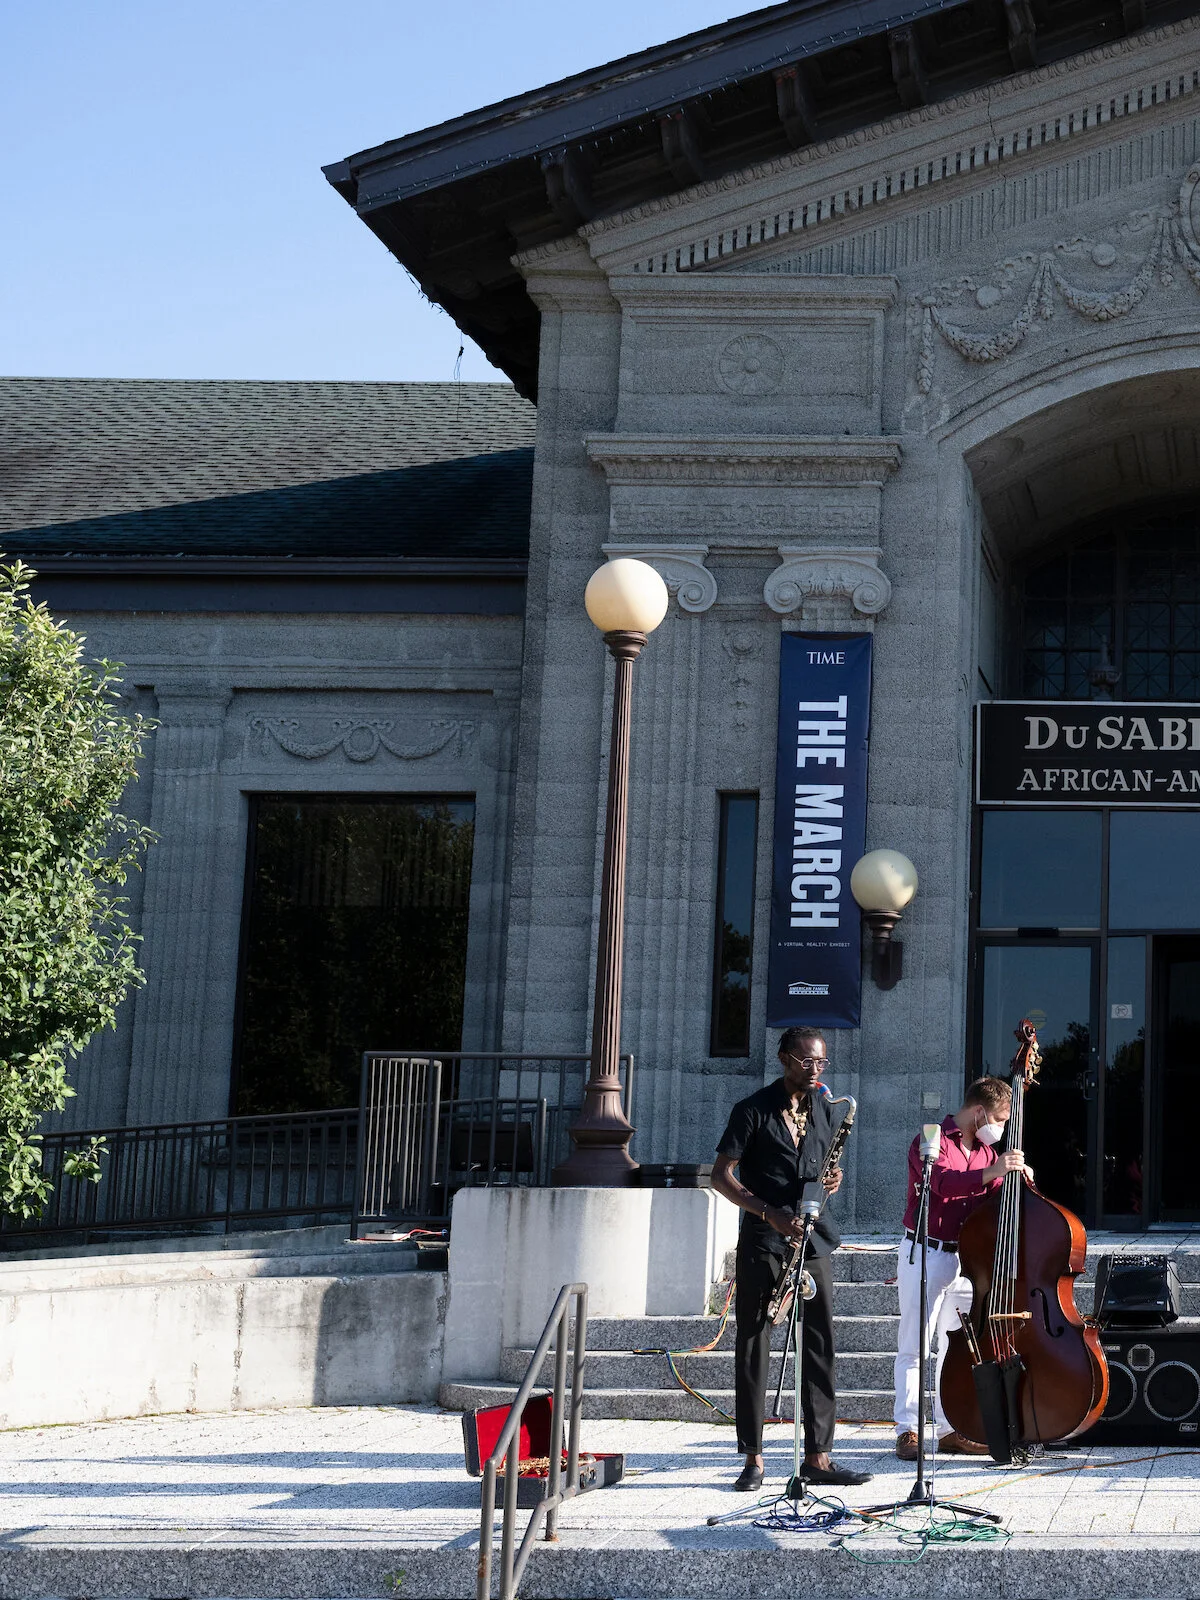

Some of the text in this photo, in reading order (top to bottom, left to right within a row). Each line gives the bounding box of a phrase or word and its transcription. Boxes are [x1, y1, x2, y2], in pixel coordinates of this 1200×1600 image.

[806, 651, 845, 665] TIME
[796, 695, 848, 768] THE
[790, 784, 845, 928] MARCH
